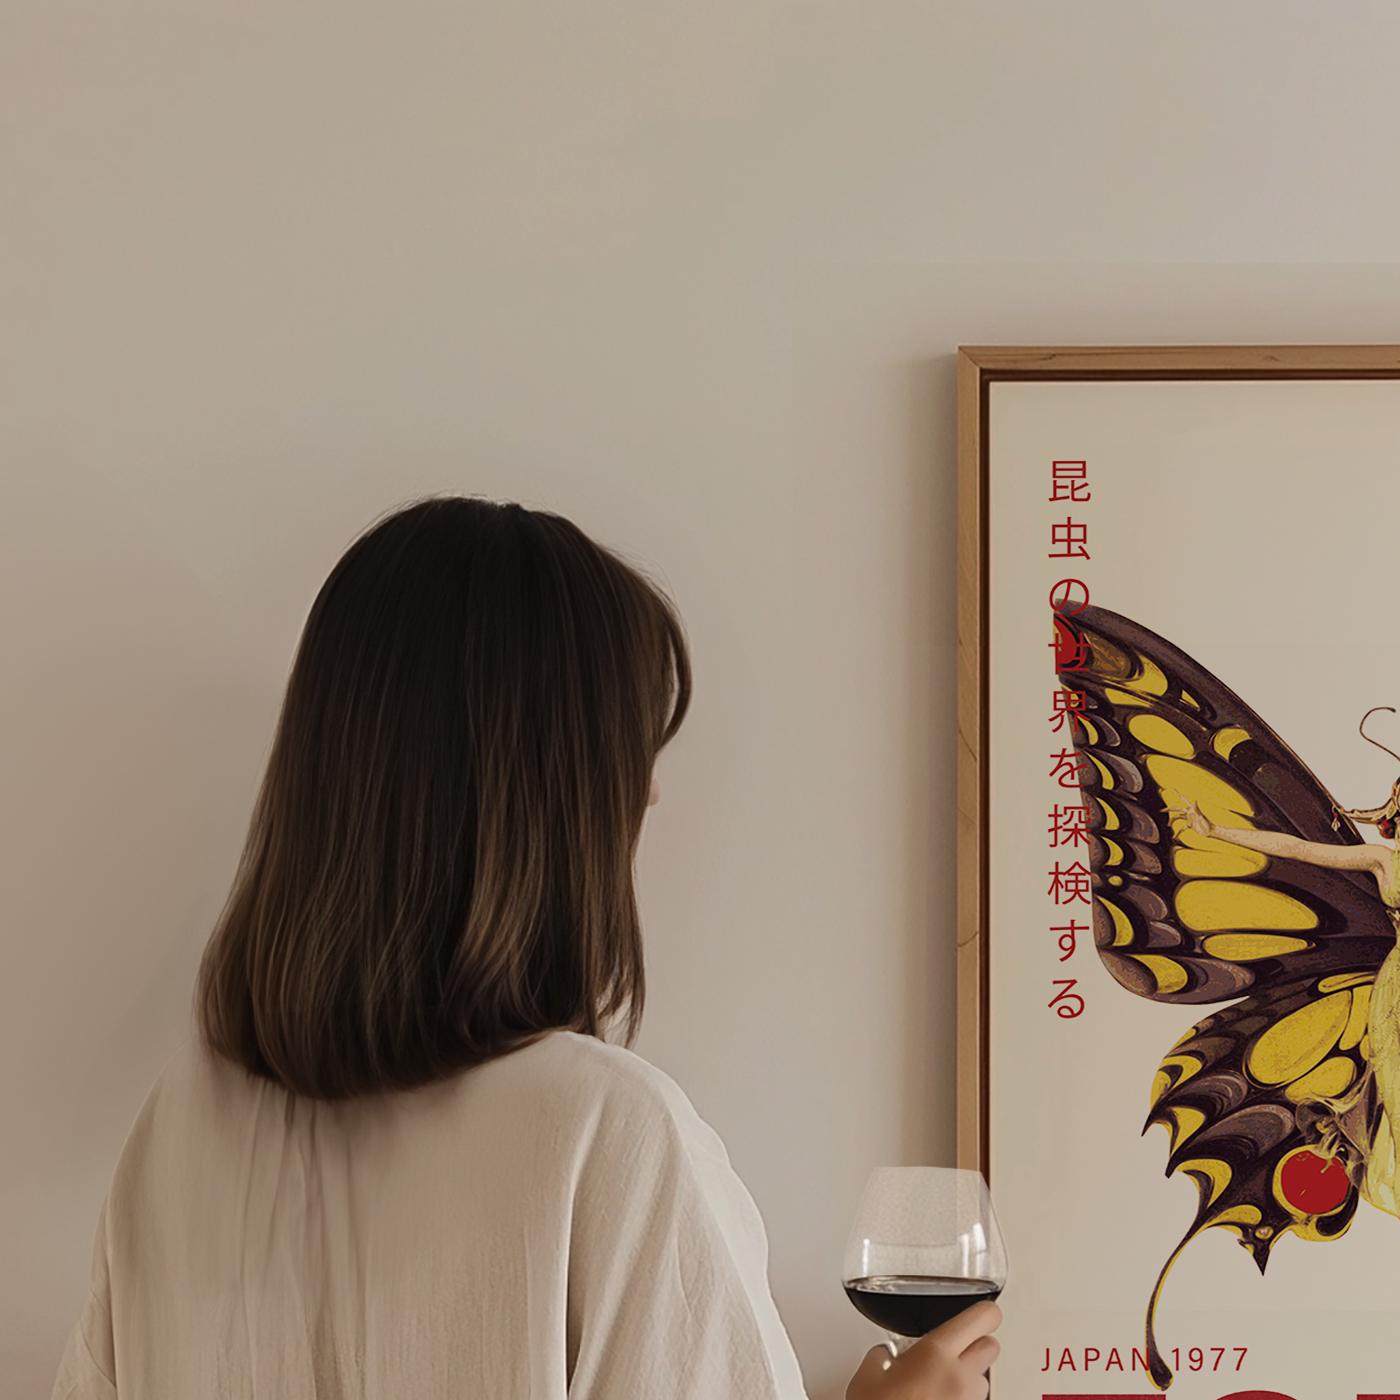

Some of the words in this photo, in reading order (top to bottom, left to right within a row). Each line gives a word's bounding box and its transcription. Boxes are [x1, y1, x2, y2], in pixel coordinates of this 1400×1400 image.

[1047, 460, 1091, 1019] 昆虫の世界を探検する
[1041, 1347, 1150, 1372] JAPAN
[1171, 1347, 1248, 1372] 1977
